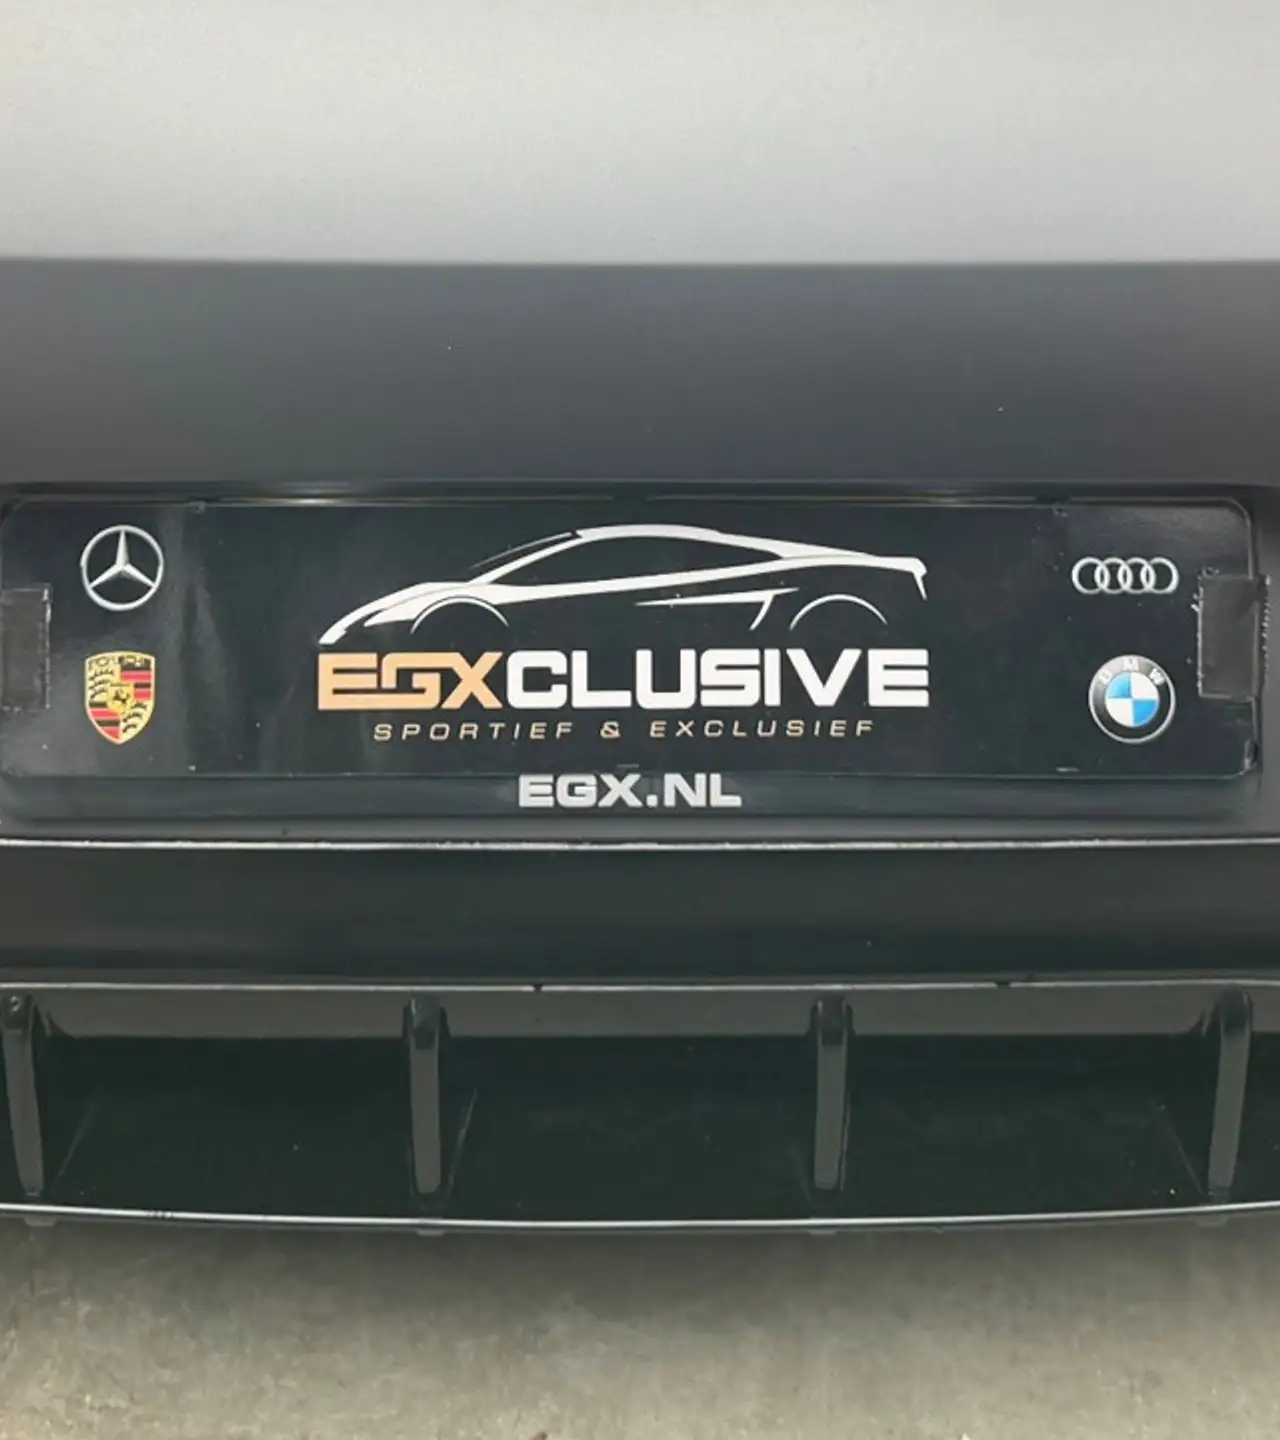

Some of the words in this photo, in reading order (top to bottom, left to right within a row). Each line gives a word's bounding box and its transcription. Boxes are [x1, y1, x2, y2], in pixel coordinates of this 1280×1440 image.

[318, 648, 930, 710] EGXCLUSIVE
[373, 722, 573, 740] SPORTIEF
[600, 720, 622, 739] &
[649, 719, 873, 738] EXCLUSIEF
[519, 772, 742, 807] EGX.NL
